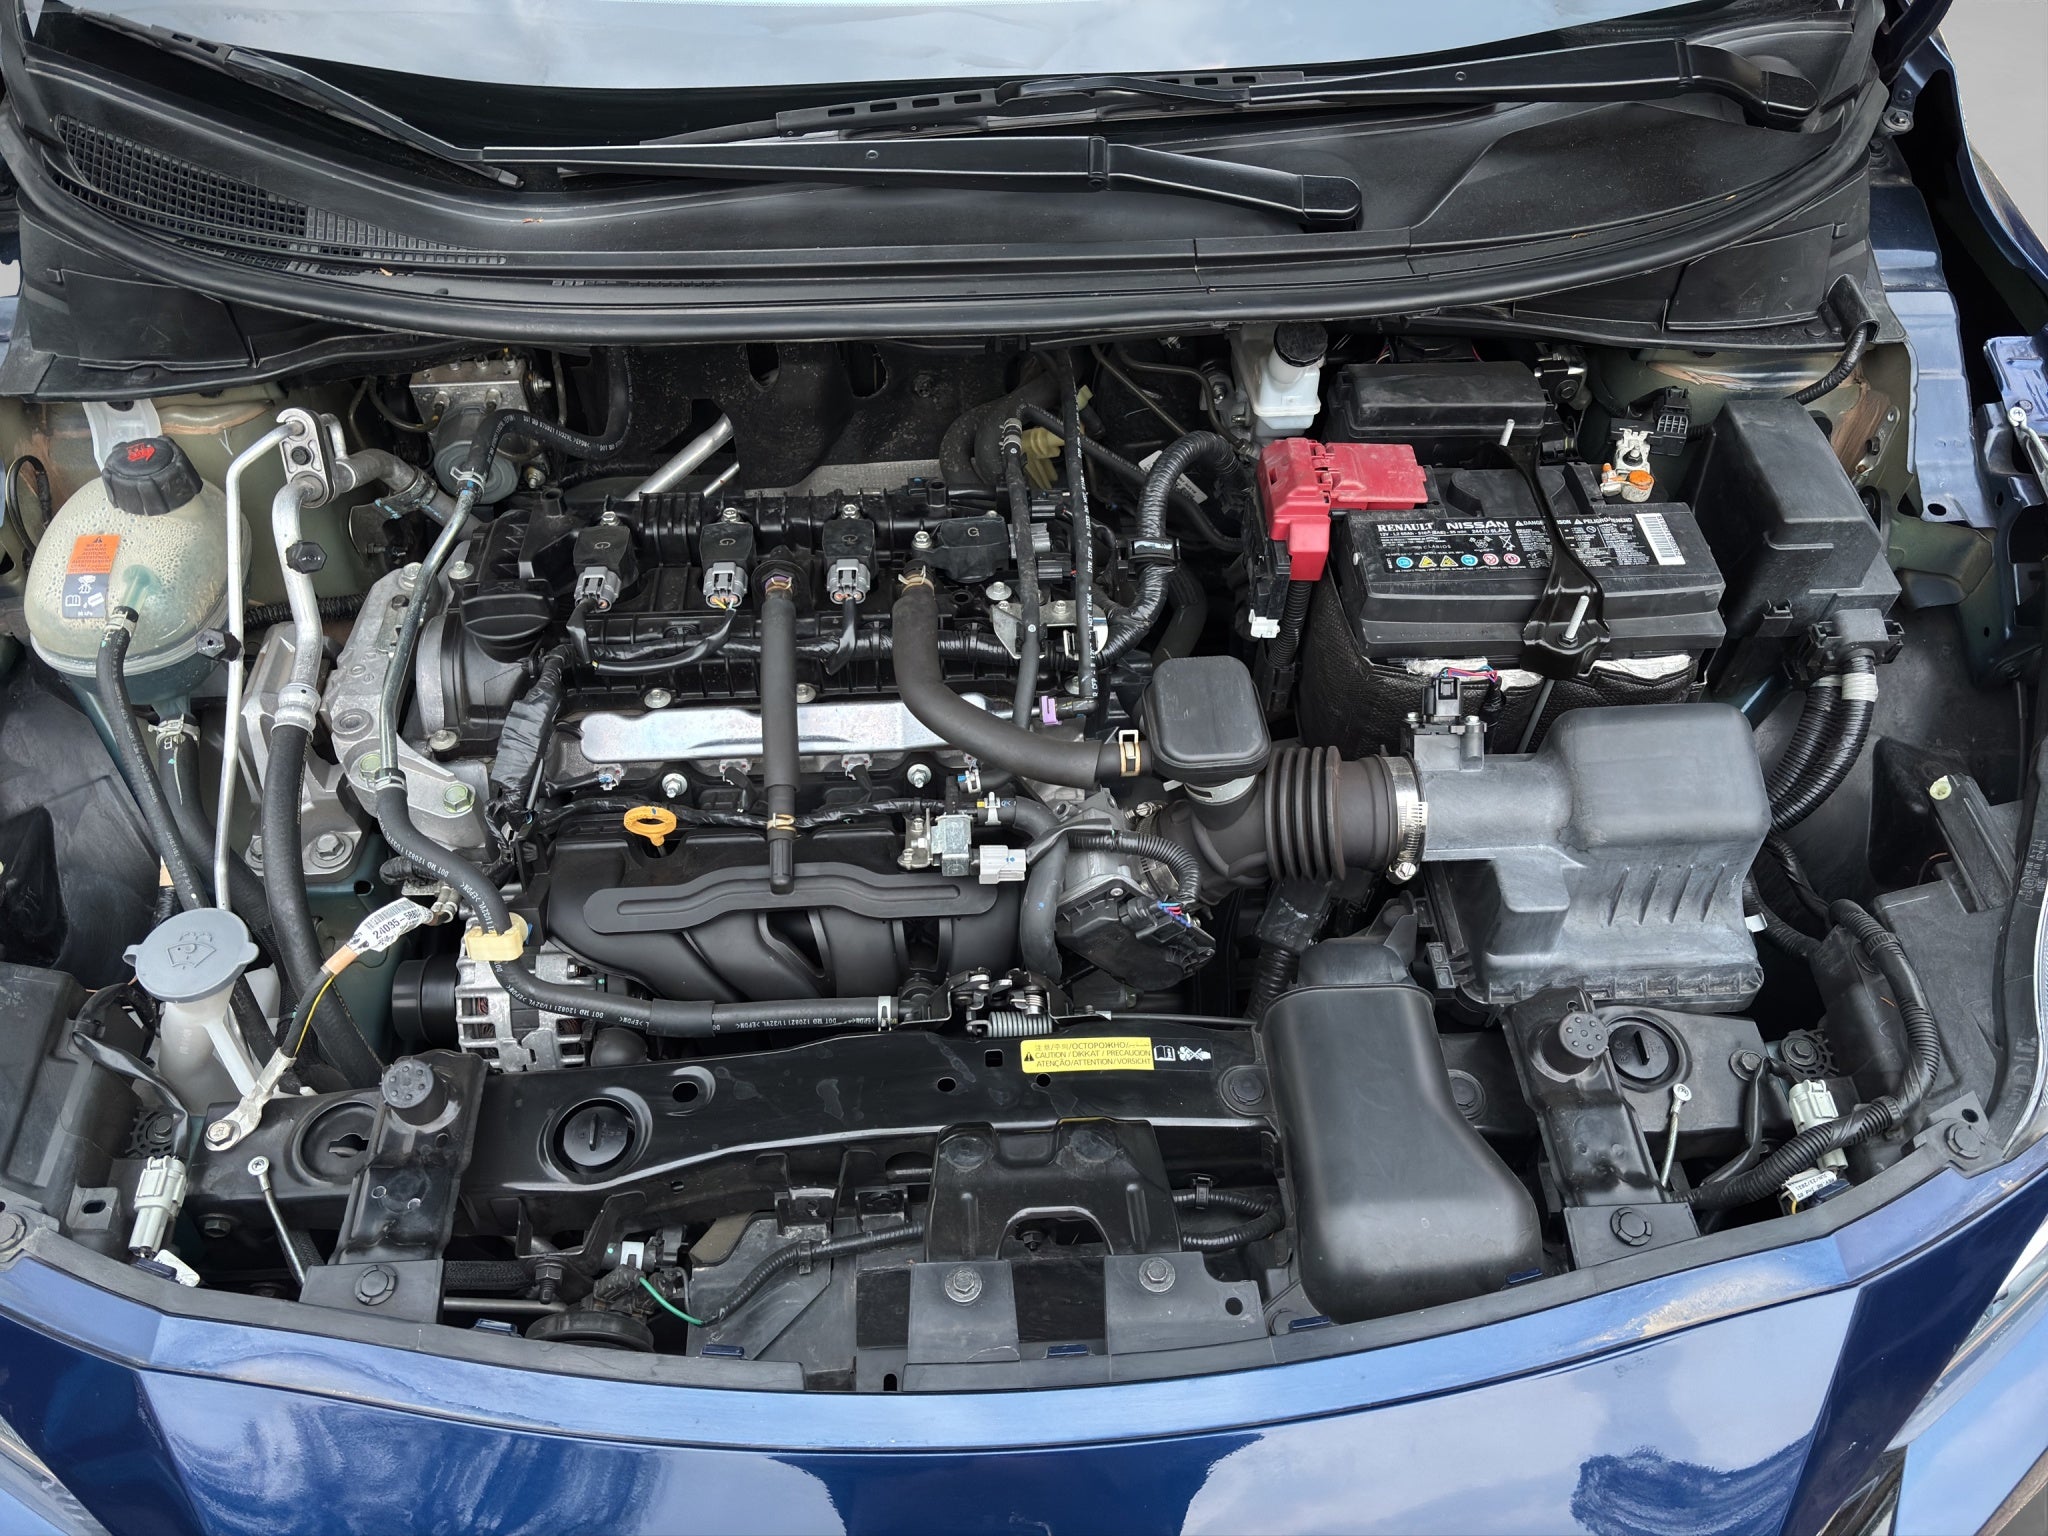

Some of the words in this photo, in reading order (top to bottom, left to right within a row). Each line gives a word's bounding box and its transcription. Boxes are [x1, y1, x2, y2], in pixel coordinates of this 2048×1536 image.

[1377, 522, 1434, 532] RENAULT
[1446, 520, 1508, 530] NISSAN
[1035, 1051, 1067, 1059] CAUTION
